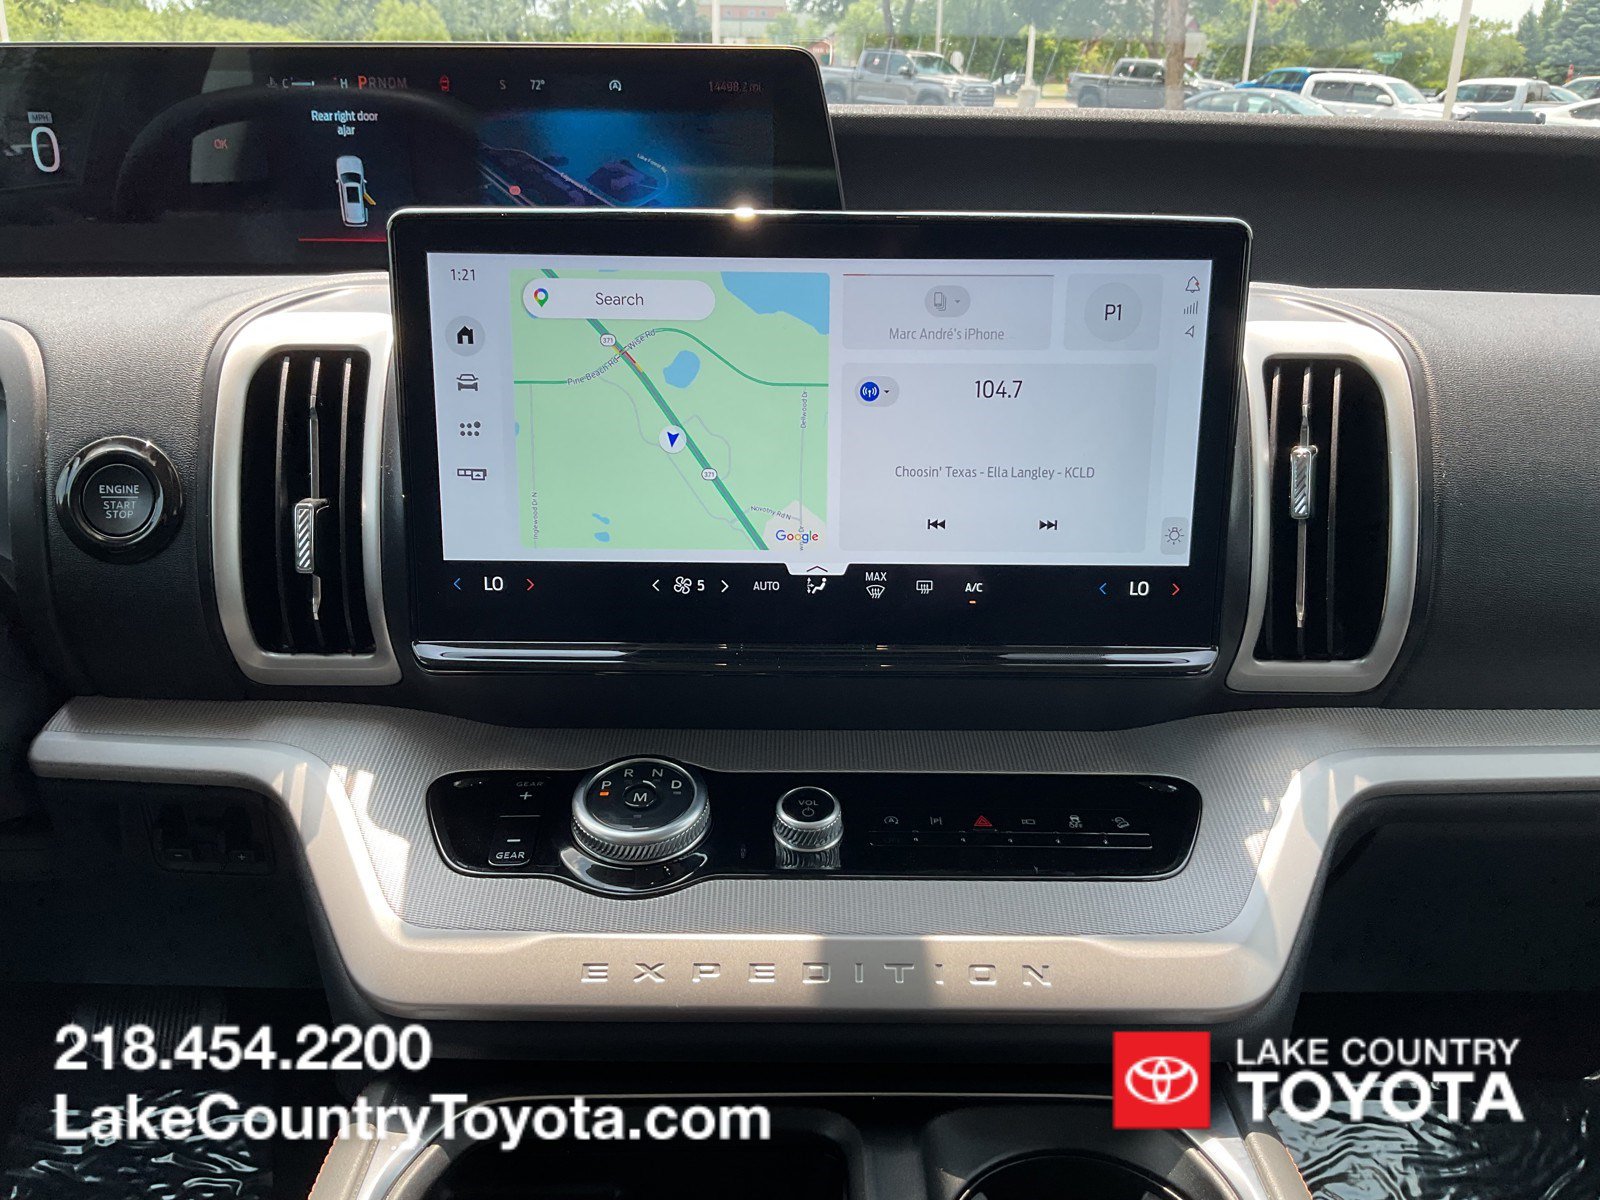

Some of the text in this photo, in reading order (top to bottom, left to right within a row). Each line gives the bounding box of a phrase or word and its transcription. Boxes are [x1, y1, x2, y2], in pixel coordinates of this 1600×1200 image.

[311, 109, 379, 124] Rear right door
[337, 124, 356, 137] ajar
[30, 126, 61, 173] 0
[213, 138, 229, 150] OK
[450, 269, 476, 282] 1:21
[595, 292, 644, 307] Search
[1104, 304, 1123, 322] P1
[602, 336, 614, 344] 371
[627, 329, 657, 351] Wise Rd
[889, 328, 1005, 341] Marc André's iPhone
[566, 355, 620, 387] Pine Beach Rd
[974, 380, 1023, 399] 104.7
[704, 471, 715, 479] 371
[895, 465, 943, 479] Choosin'
[945, 466, 978, 479] Texas
[987, 466, 1009, 479] Ella
[1011, 466, 1056, 481] Langley
[1065, 467, 1095, 479] KCLD
[99, 485, 140, 494] ENGINE
[103, 501, 136, 510] START
[751, 505, 776, 516] Novotny
[105, 510, 134, 519] STOP
[775, 529, 819, 544] Google
[865, 571, 887, 582] MAX
[484, 576, 504, 592] LO
[697, 580, 705, 591] 5
[752, 581, 780, 592] AUTO
[965, 582, 983, 593] A/C
[1129, 581, 1150, 597] LO
[624, 768, 634, 778] R
[652, 768, 663, 778] N
[601, 780, 612, 790] P
[671, 780, 681, 790] D
[633, 791, 648, 803] M
[798, 799, 819, 807] VOL
[495, 851, 526, 860] GEAR
[580, 962, 1052, 986] EXPEDITION
